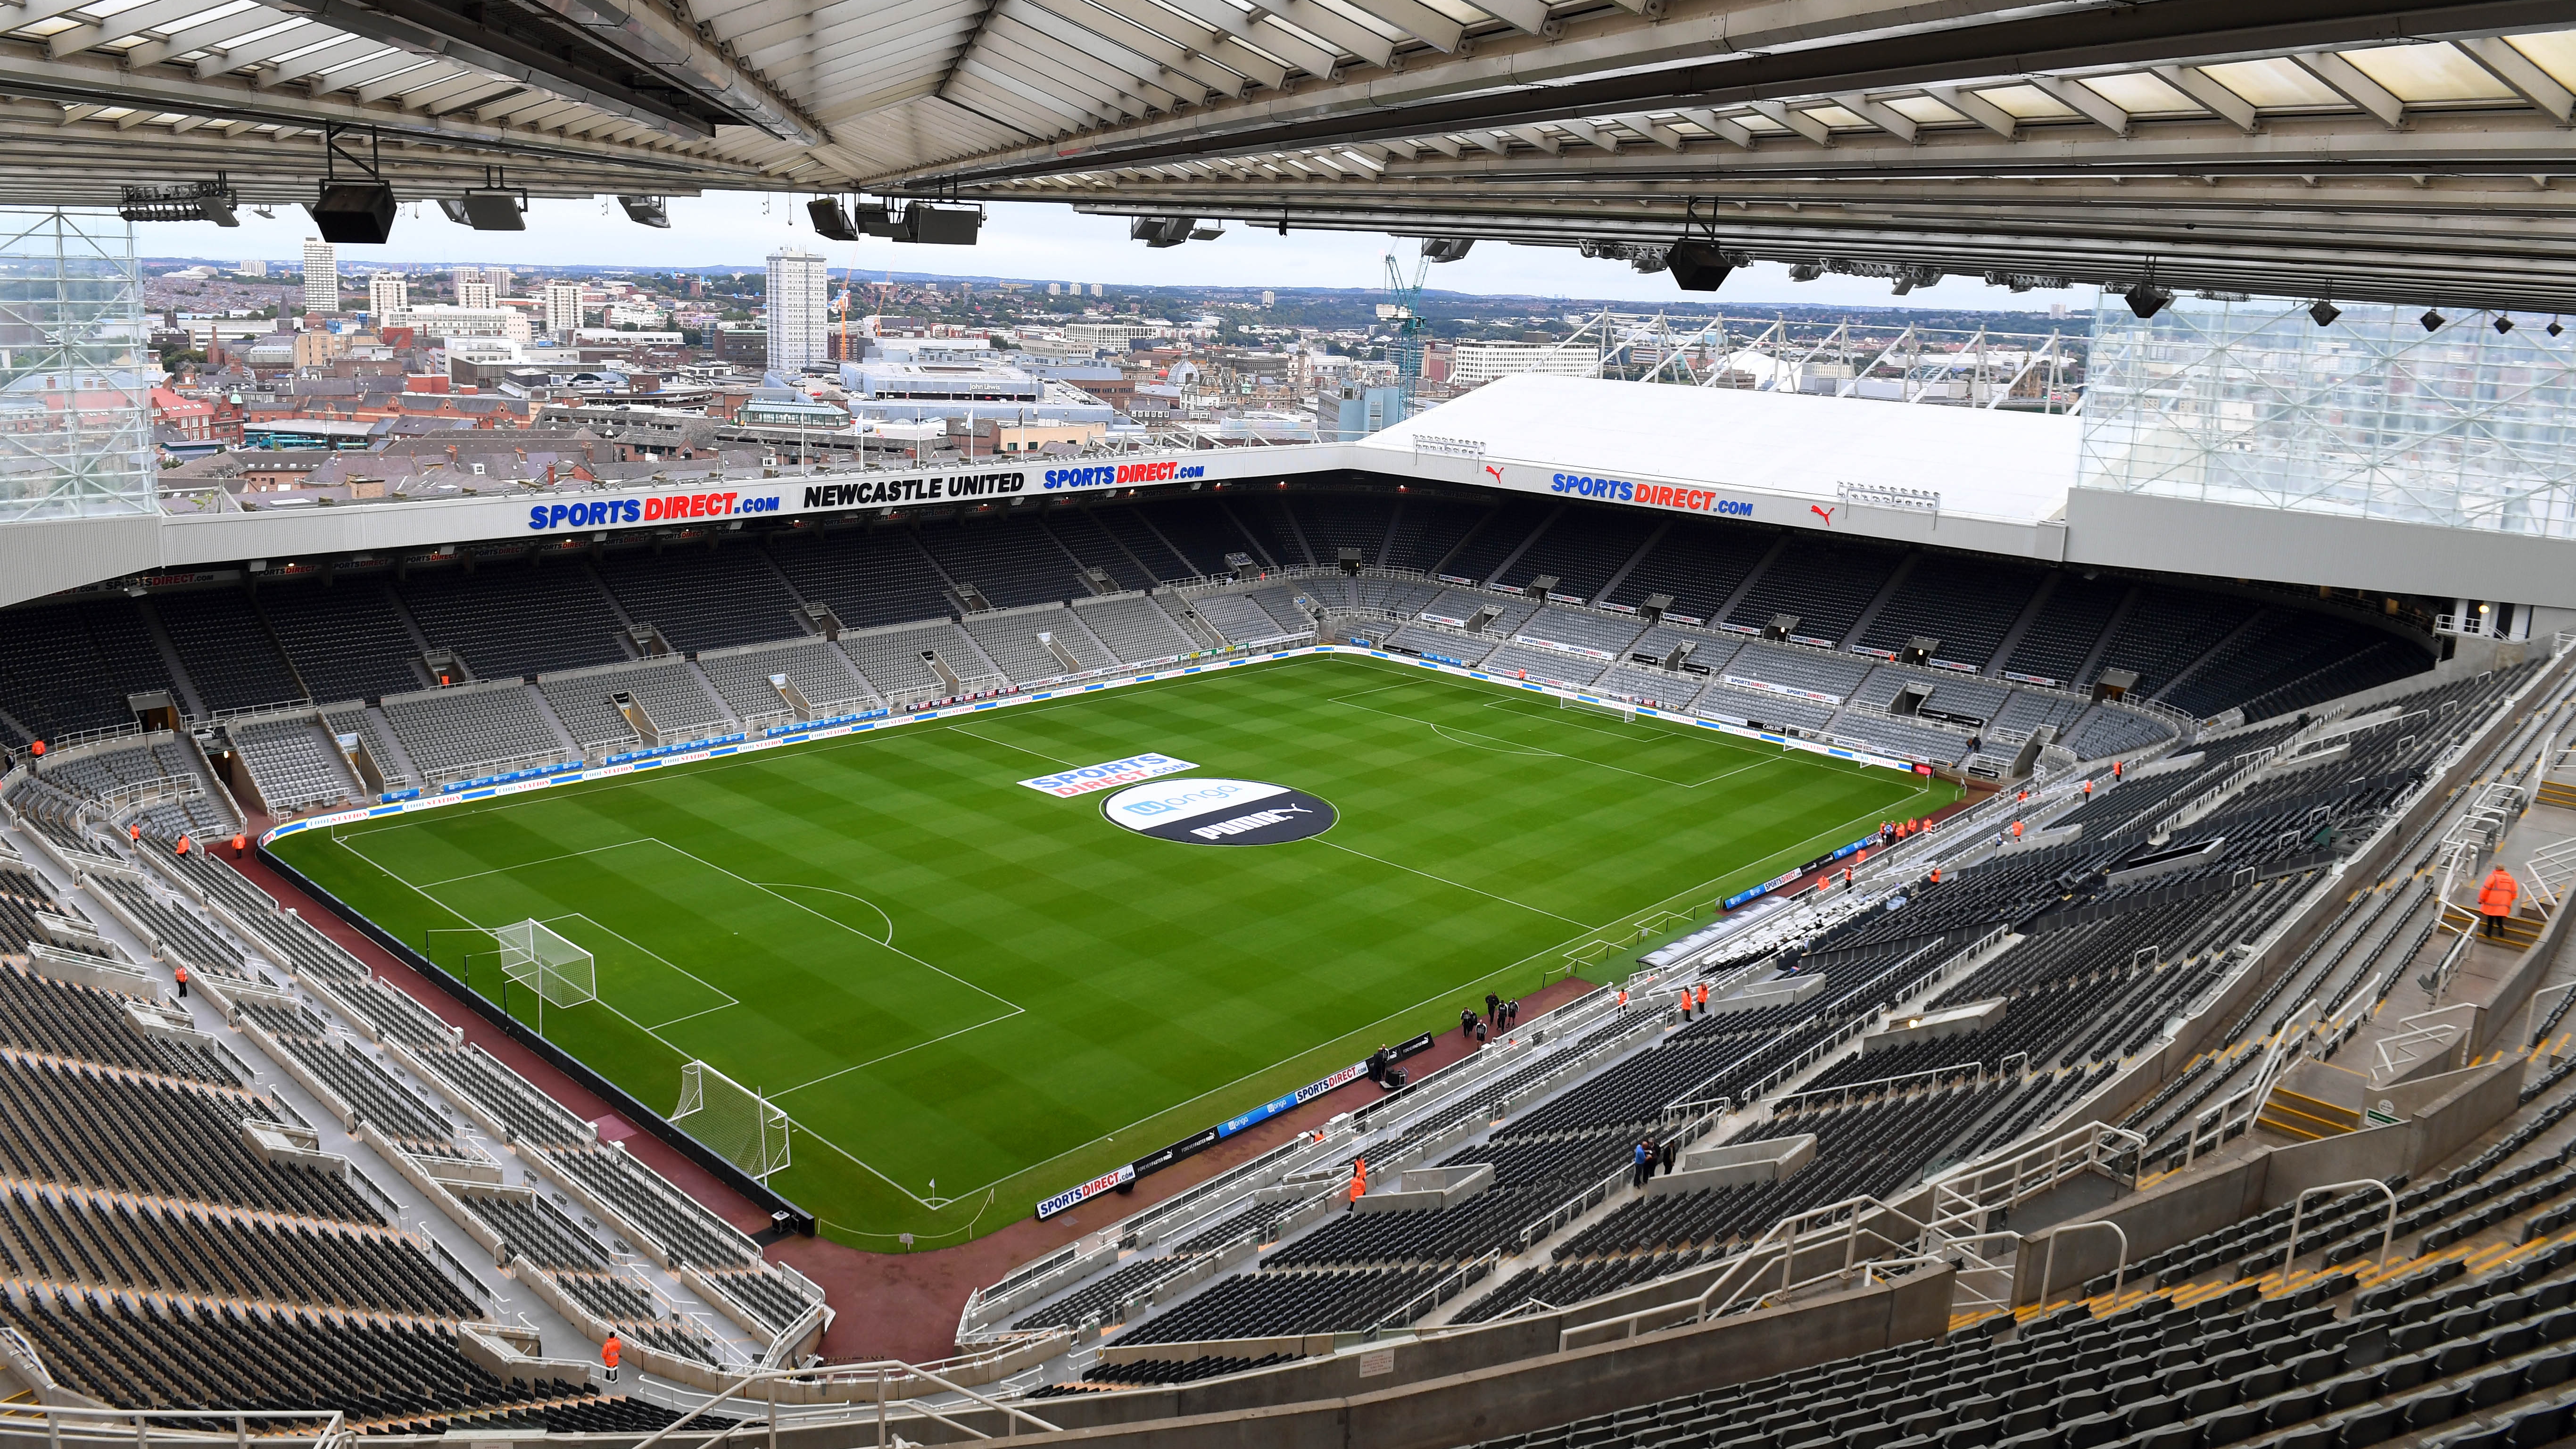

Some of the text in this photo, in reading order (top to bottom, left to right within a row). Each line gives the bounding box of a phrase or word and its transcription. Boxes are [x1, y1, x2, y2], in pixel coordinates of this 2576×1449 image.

[969, 383, 983, 391] John
[804, 473, 1024, 508] NEWCASTLE UNITED
[105, 574, 214, 590] SPSDIRECT.COM
[1180, 651, 1212, 660] bet365.com
[1217, 645, 1247, 654] bet365.com
[1763, 724, 1782, 732] CARLING
[1031, 754, 1168, 789] SPORTS
[1053, 762, 1190, 796] DIRECT.COM
[1122, 785, 1243, 816] wonga
[1190, 807, 1287, 840] PUMA
[1267, 1099, 1286, 1113] wonga
[1228, 1116, 1248, 1131] wonga
